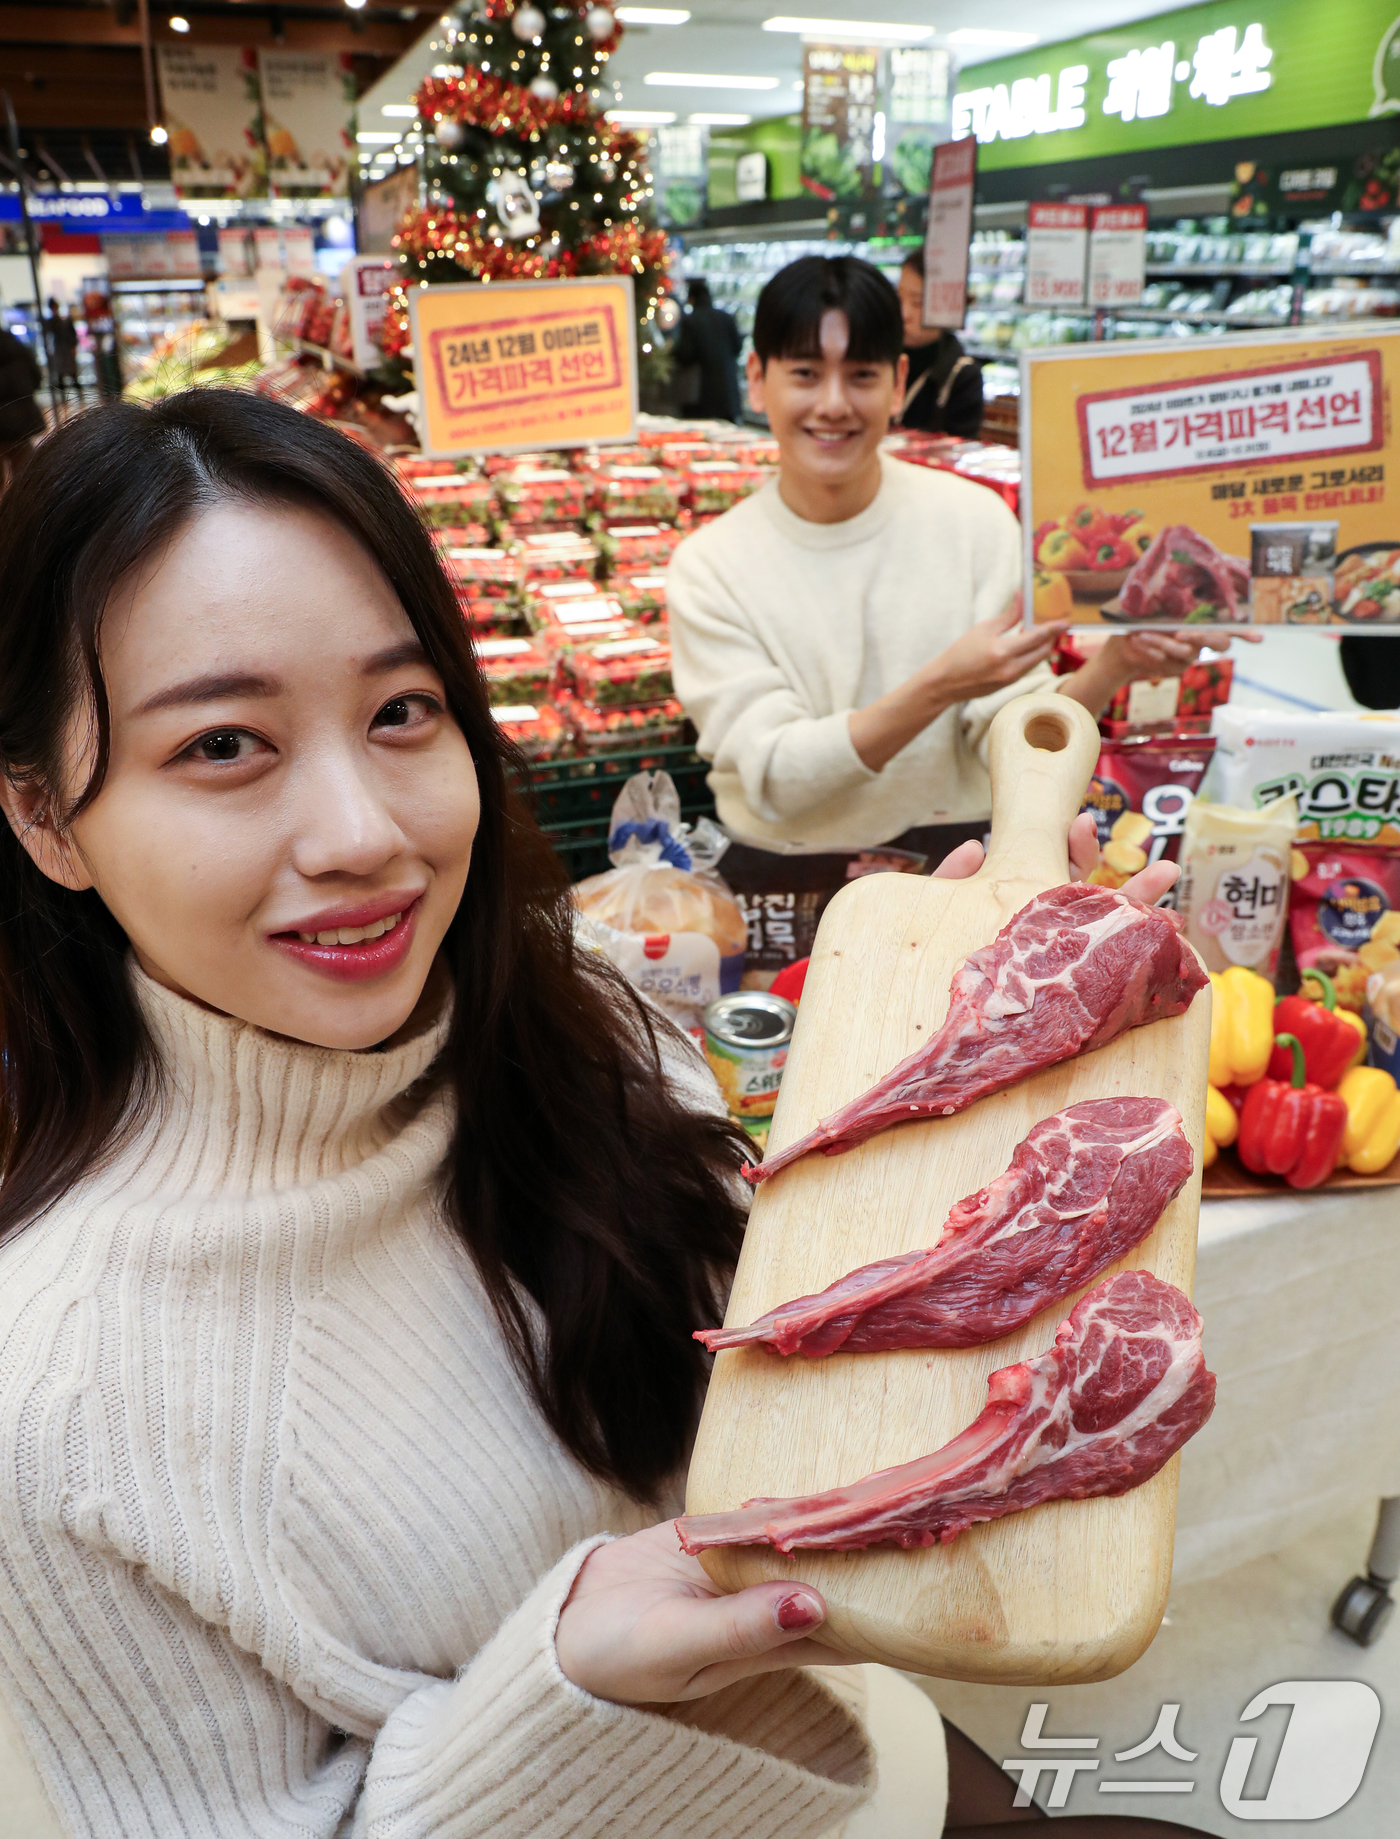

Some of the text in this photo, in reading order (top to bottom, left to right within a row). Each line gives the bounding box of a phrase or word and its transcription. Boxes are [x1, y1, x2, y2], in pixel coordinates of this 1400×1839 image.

[952, 66, 1088, 143] ETABLE
[1103, 23, 1273, 121] 과일·채소
[447, 322, 600, 366] 24년 12월 이마트
[453, 351, 605, 399] 가격파격 선언
[1097, 420, 1158, 459] 12월
[1165, 400, 1290, 448] 가격파격
[1296, 391, 1362, 431] 선언
[1211, 464, 1384, 501] 매달 새로운 그로서리
[1263, 495, 1298, 516] 품목
[1310, 752, 1374, 770] 대한민국
[1259, 778, 1400, 814] 카스타
[1223, 873, 1286, 920] 현미
